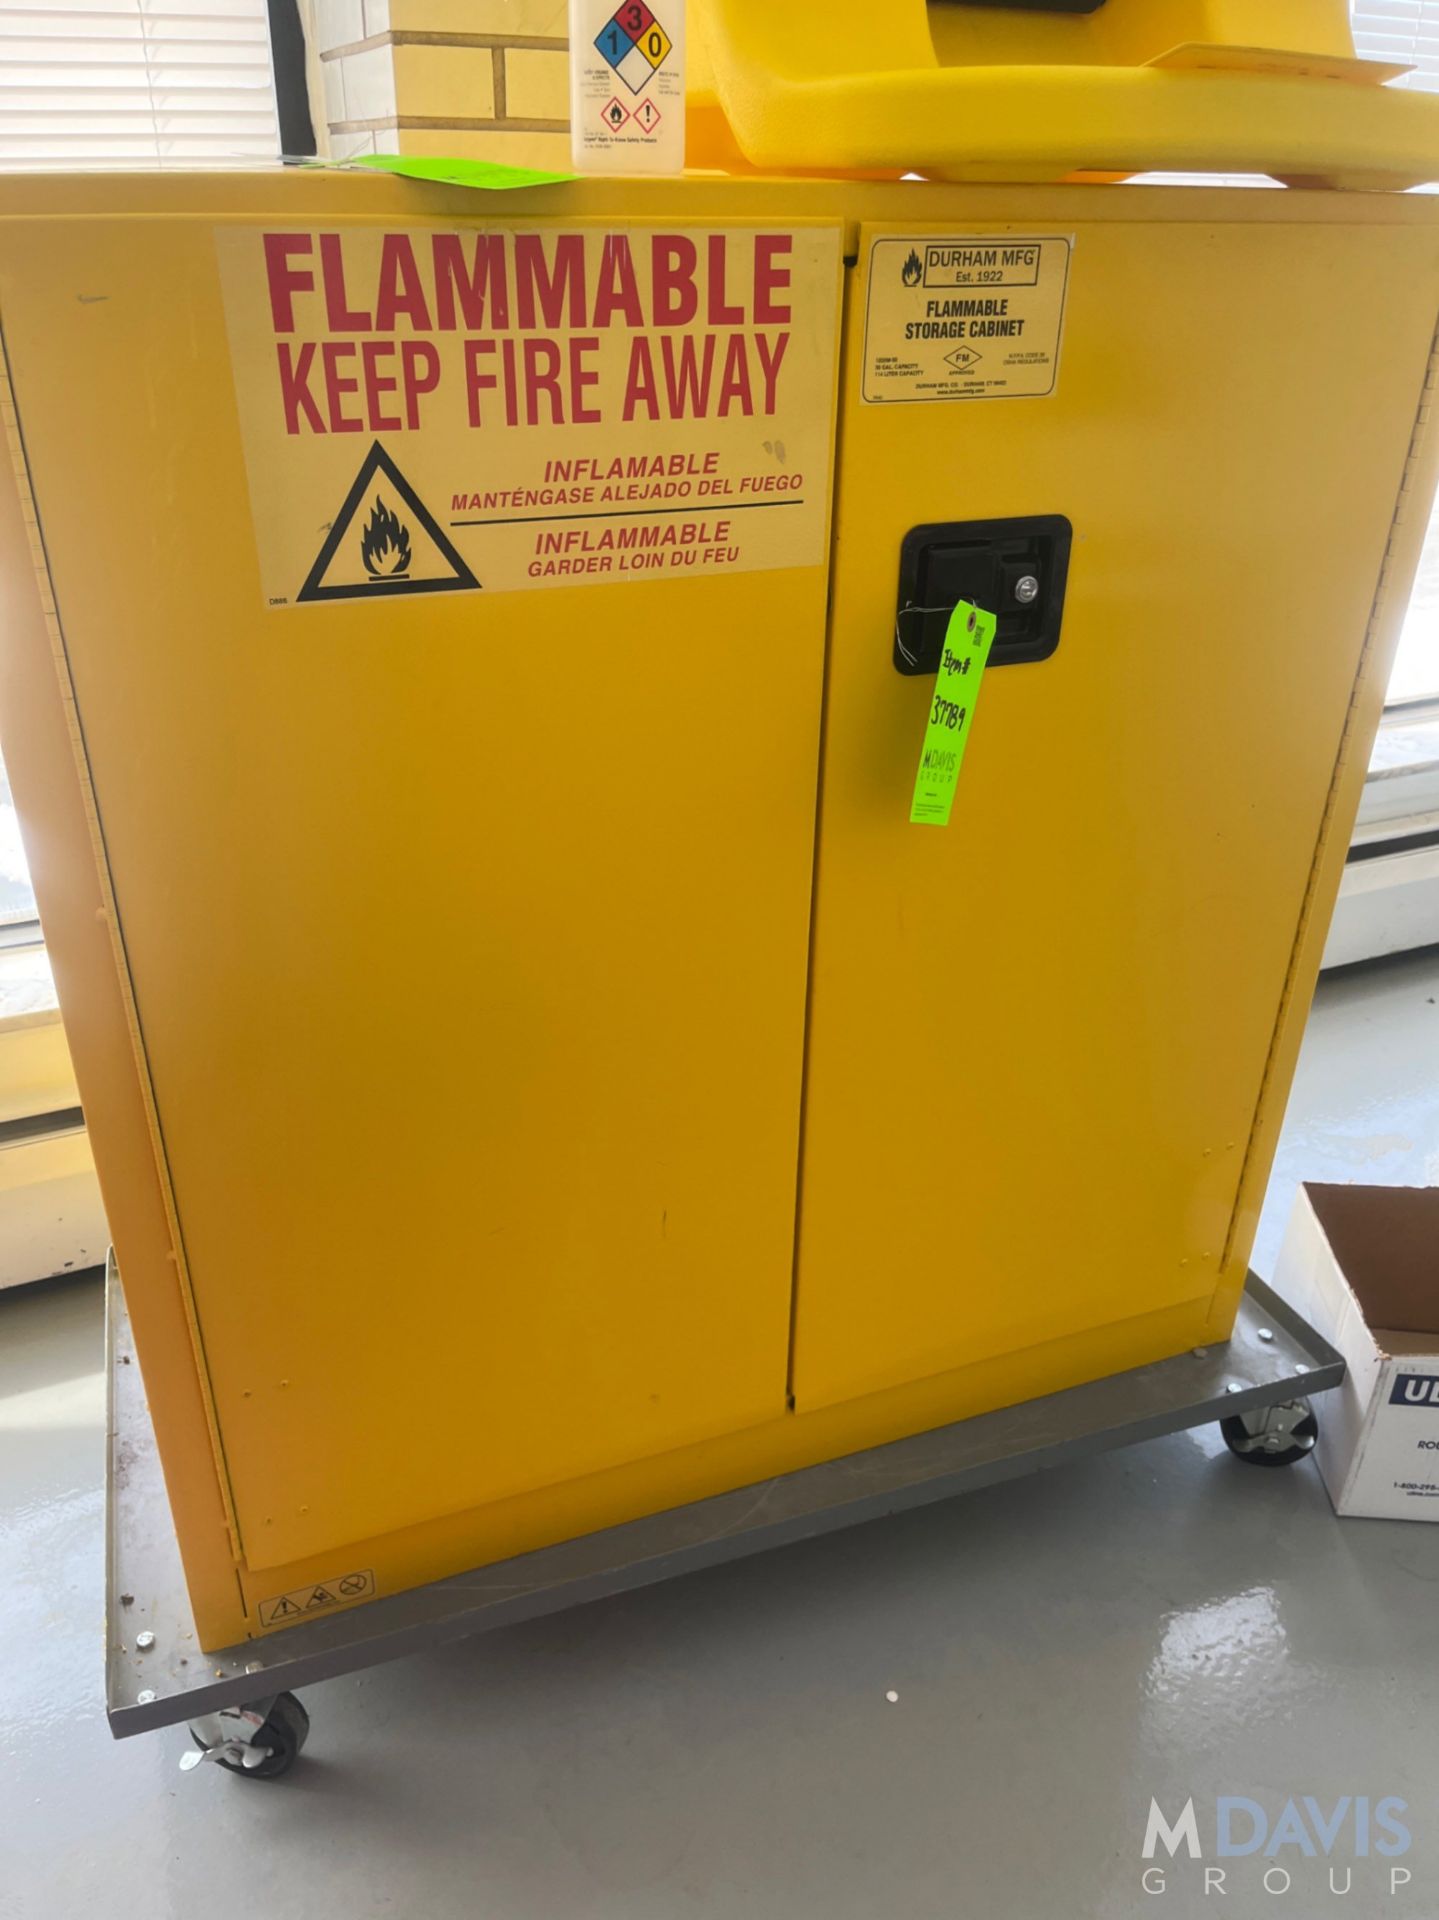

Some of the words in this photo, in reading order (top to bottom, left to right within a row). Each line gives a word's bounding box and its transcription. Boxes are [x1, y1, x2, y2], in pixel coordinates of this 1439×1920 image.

[627, 5, 642, 31] 3
[607, 30, 618, 55] 1
[648, 32, 662, 58] 0
[928, 250, 997, 267] DURHAM
[1001, 249, 1035, 266] MFG
[262, 233, 793, 333] FLAMMABLE
[955, 272, 974, 282] Est.
[976, 271, 1004, 282] 1922
[926, 299, 1009, 318] FLAMMABLE
[905, 322, 966, 339] STORAGE
[969, 319, 1025, 337] CABINET
[955, 353, 971, 362] FM
[276, 340, 441, 435] KEEP
[463, 337, 601, 428] FIRE
[621, 332, 791, 422] AWAY
[543, 452, 720, 483] INFLAMABLE
[451, 485, 595, 511] MANTÉNGASE
[599, 478, 693, 502] ALEJADO
[697, 476, 735, 496] DEL
[739, 473, 804, 493] FUEGO
[535, 521, 731, 555] INFLAMMABLE
[527, 556, 612, 578] GARDER
[617, 553, 666, 572] LOIN
[671, 549, 699, 567] DU
[702, 546, 740, 565] FEU
